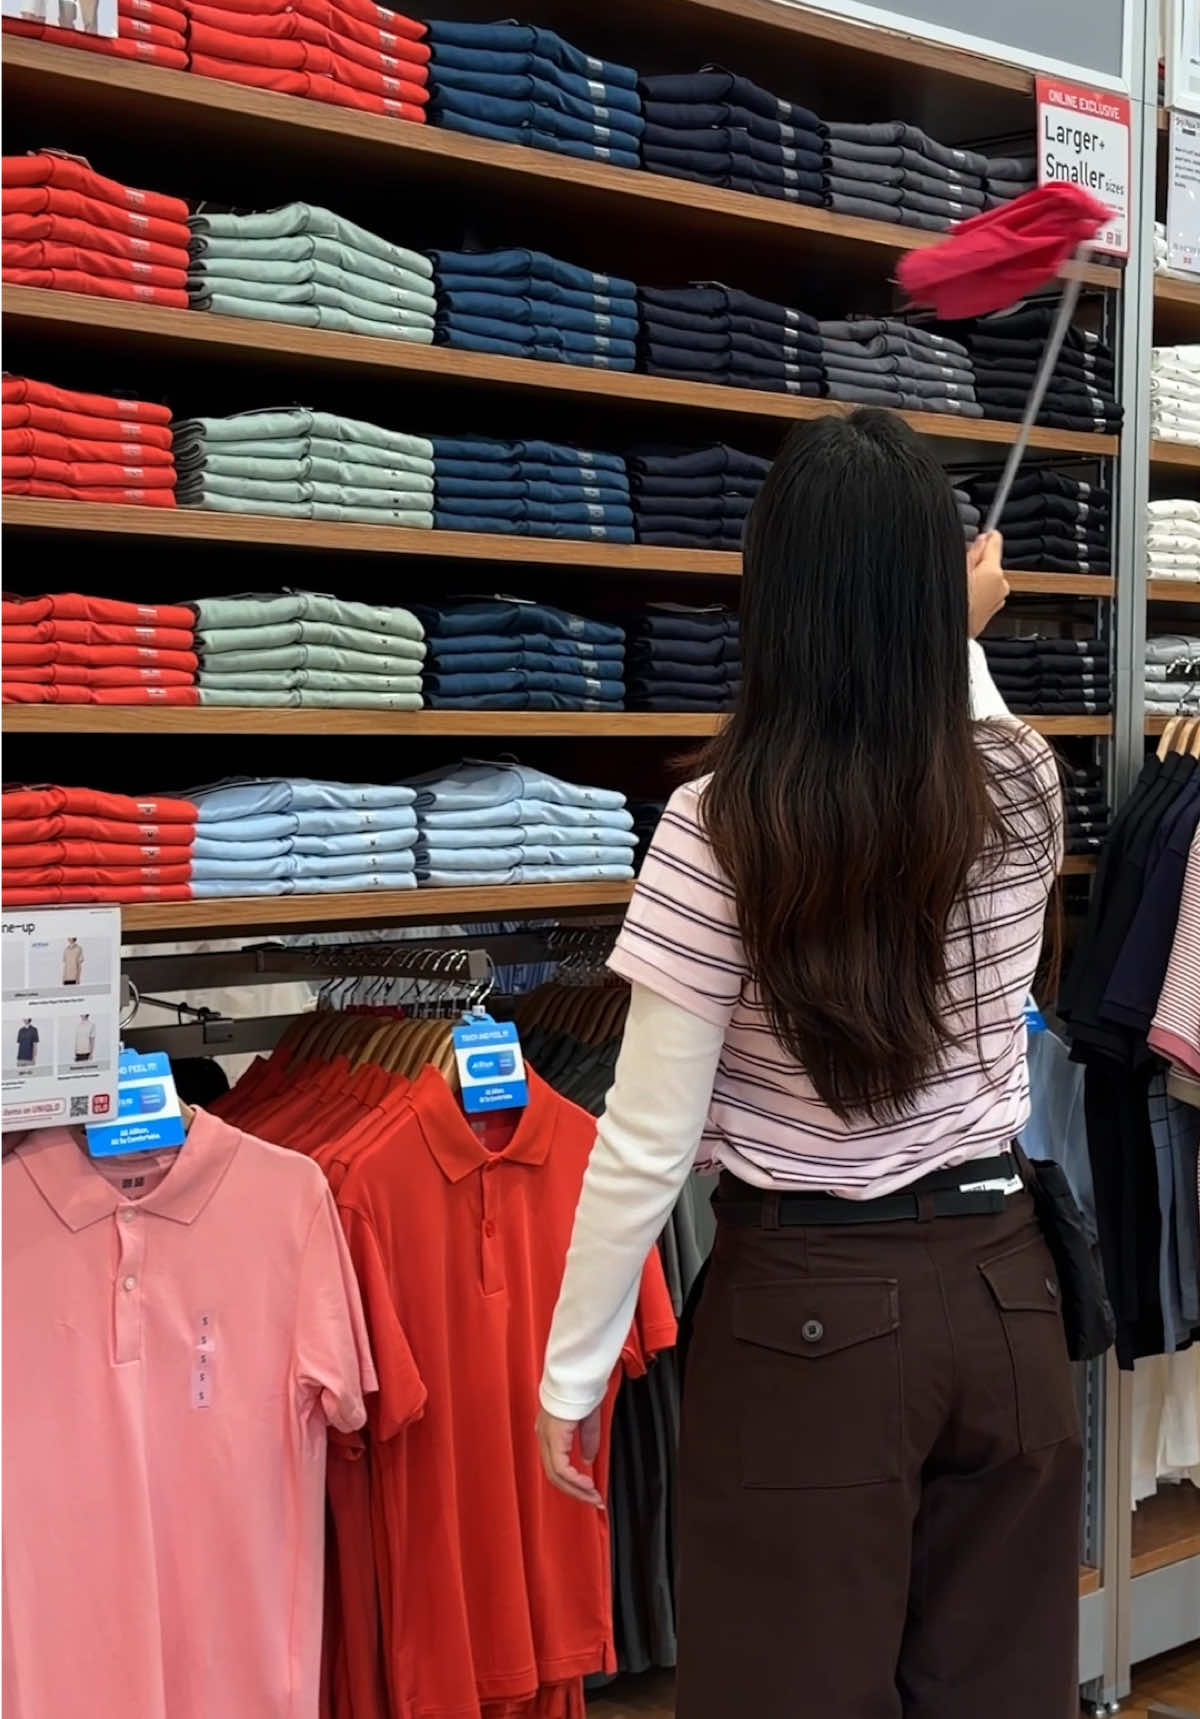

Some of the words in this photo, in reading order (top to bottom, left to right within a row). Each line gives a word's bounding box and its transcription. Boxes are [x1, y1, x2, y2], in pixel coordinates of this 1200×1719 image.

[1048, 89, 1078, 109] ONLINE
[1079, 97, 1120, 120] EXCLUSIVE
[1046, 152, 1105, 190] Smaller
[1105, 178, 1125, 196] sizes
